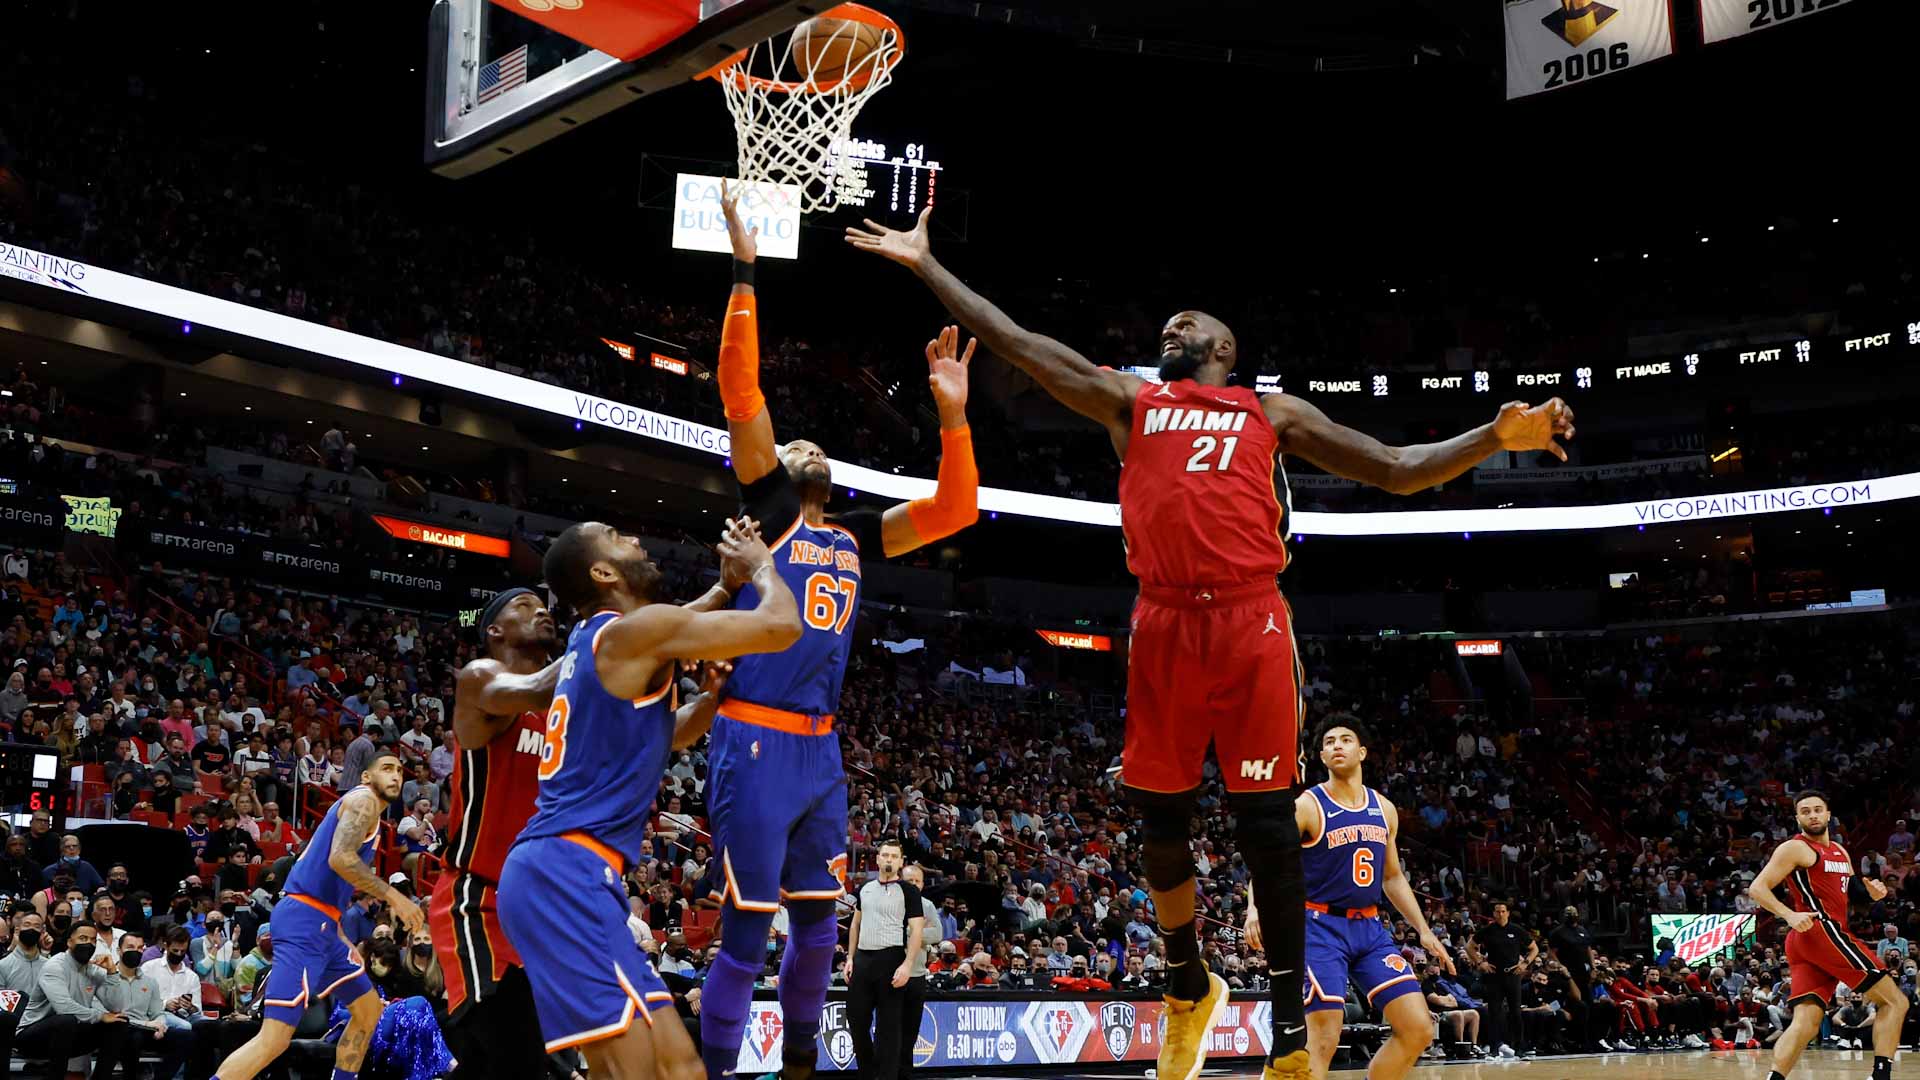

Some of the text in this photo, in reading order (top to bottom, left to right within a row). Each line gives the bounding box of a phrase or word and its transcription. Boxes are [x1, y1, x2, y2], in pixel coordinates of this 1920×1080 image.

[1544, 42, 1630, 89] 2006
[906, 143, 924, 160] 61
[894, 165, 900, 174] 2
[912, 167, 916, 176] 1
[930, 169, 936, 177] 3
[894, 174, 899, 183] 1
[910, 176, 917, 185] 2
[928, 178, 935, 187] 0
[892, 183, 899, 192] 2
[910, 185, 917, 194] 2
[928, 187, 934, 196] 3
[892, 192, 898, 201] 3
[909, 194, 916, 203] 0
[927, 197, 934, 206] 4
[891, 202, 898, 211] 0
[908, 204, 915, 213] 2
[680, 208, 793, 239] BUSELO
[1795, 341, 1810, 352] 16
[1845, 333, 1891, 352] FT PCT
[1684, 354, 1699, 365] 15
[1739, 349, 1781, 364] FT ATT
[1796, 352, 1809, 362] 11
[1474, 371, 1489, 382] 50
[1576, 367, 1592, 378] 60
[1616, 362, 1671, 379] FT MADE
[1687, 365, 1696, 375] 6
[1309, 381, 1361, 392] FG MADE
[1373, 375, 1387, 386] 30
[1422, 377, 1462, 389] FG ATT
[1475, 382, 1489, 392] 54
[1517, 373, 1561, 385] FG PCT
[1577, 378, 1591, 388] 41
[1374, 386, 1388, 396] 22
[575, 396, 731, 453] VICOPAINTING.C
[1143, 407, 1248, 436] MIAMI
[1186, 435, 1240, 472] 21
[1635, 484, 1872, 521] VICOPAINTING.COM
[4, 508, 53, 526] arena
[165, 536, 235, 554] FTX arena
[423, 530, 466, 548] BACARDÍ
[789, 540, 835, 566] NEW
[276, 554, 339, 573] FTX arena
[382, 571, 442, 591] FTX arena
[804, 571, 857, 635] 67
[1059, 635, 1093, 648] BACARDÍ
[1457, 640, 1499, 654] BACARDÍ
[30, 792, 55, 810] 61
[1326, 824, 1387, 849] NEW YORK
[1353, 847, 1374, 887] 6
[1824, 860, 1850, 874] MIAMI
[957, 1006, 1007, 1031] SATURDAY
[1102, 1005, 1134, 1029] NETS
[1140, 1023, 1152, 1044] VS
[1215, 1033, 1224, 1051] PM
[1225, 1032, 1233, 1051] ET
[1235, 1036, 1248, 1045] abc
[947, 1034, 995, 1059] 8:30 PM ET
[998, 1041, 1015, 1051] abc
